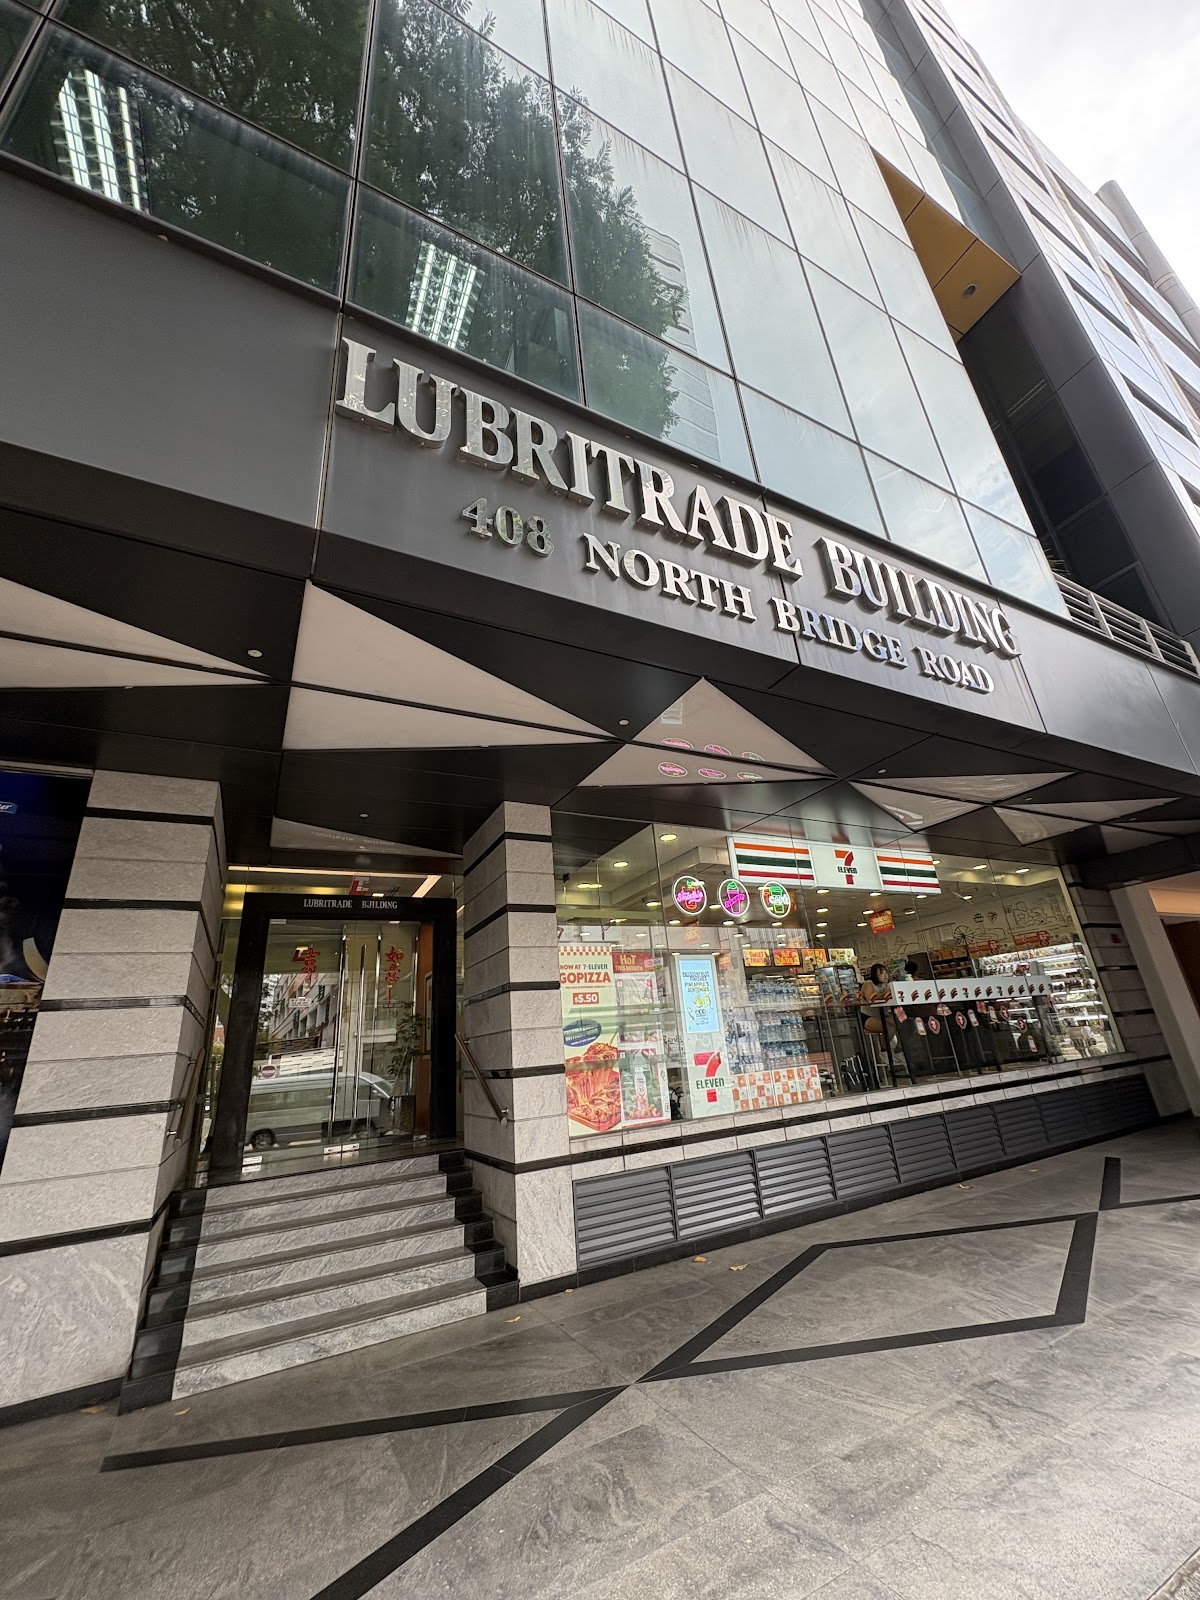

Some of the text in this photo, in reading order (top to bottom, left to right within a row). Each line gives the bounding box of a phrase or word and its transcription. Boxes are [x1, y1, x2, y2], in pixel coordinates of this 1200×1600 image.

[335, 337, 1021, 660] LUBRITRADE BUILDING
[462, 497, 995, 695] 408 NORTH BRIDGE ROAD
[834, 850, 854, 885] 7
[303, 898, 398, 909] LUBRITRADE BUILDING
[559, 972, 611, 984] GOPIZZA
[574, 994, 598, 1003] $5.50
[693, 1051, 722, 1103] 7
